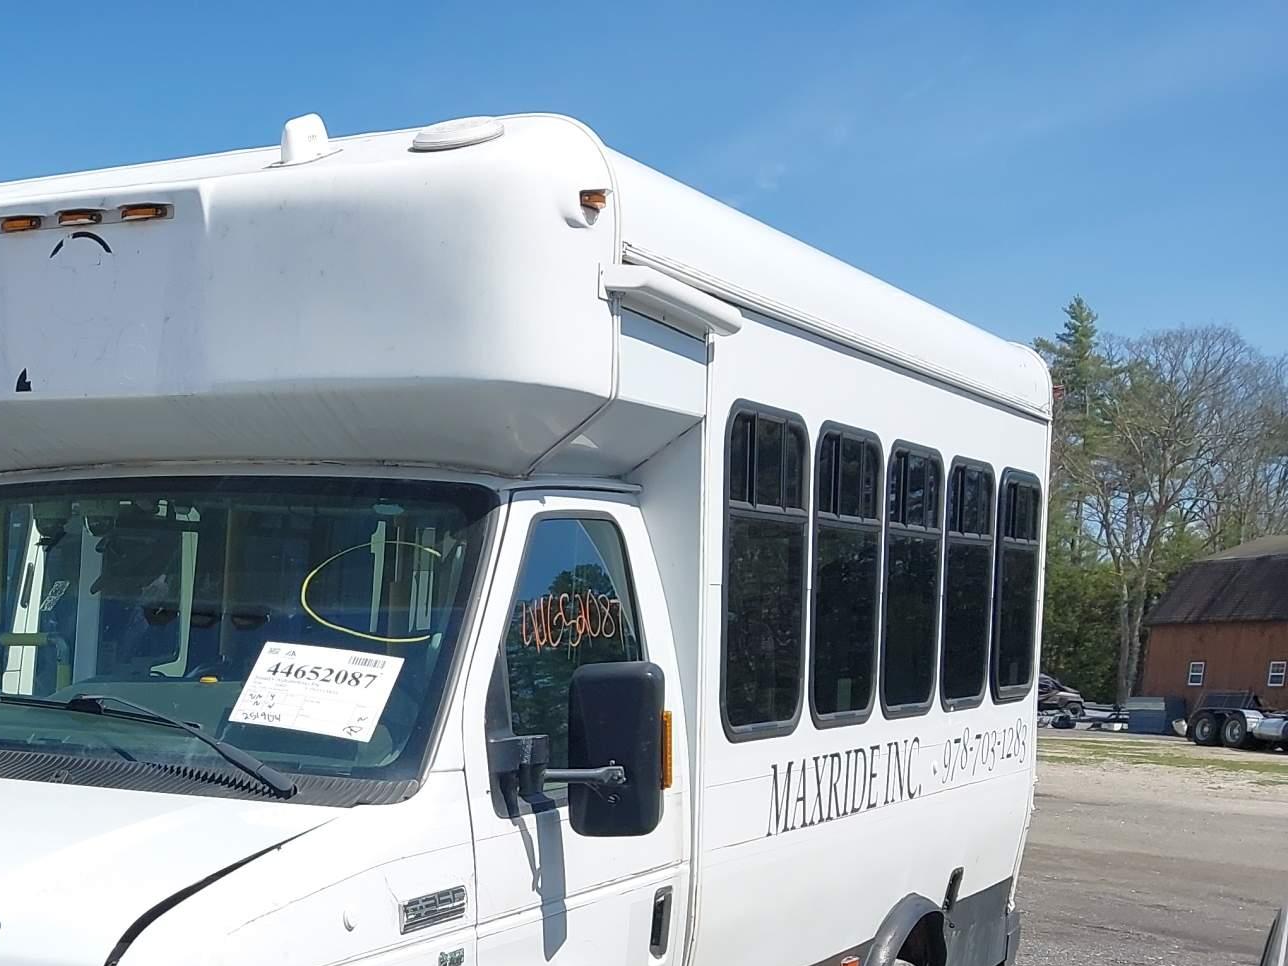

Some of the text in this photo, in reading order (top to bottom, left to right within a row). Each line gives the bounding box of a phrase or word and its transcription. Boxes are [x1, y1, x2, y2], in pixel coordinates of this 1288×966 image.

[266, 661, 378, 690] 44652087
[767, 744, 881, 837] MAXRIDE
[942, 717, 1028, 784] 978-703-1283
